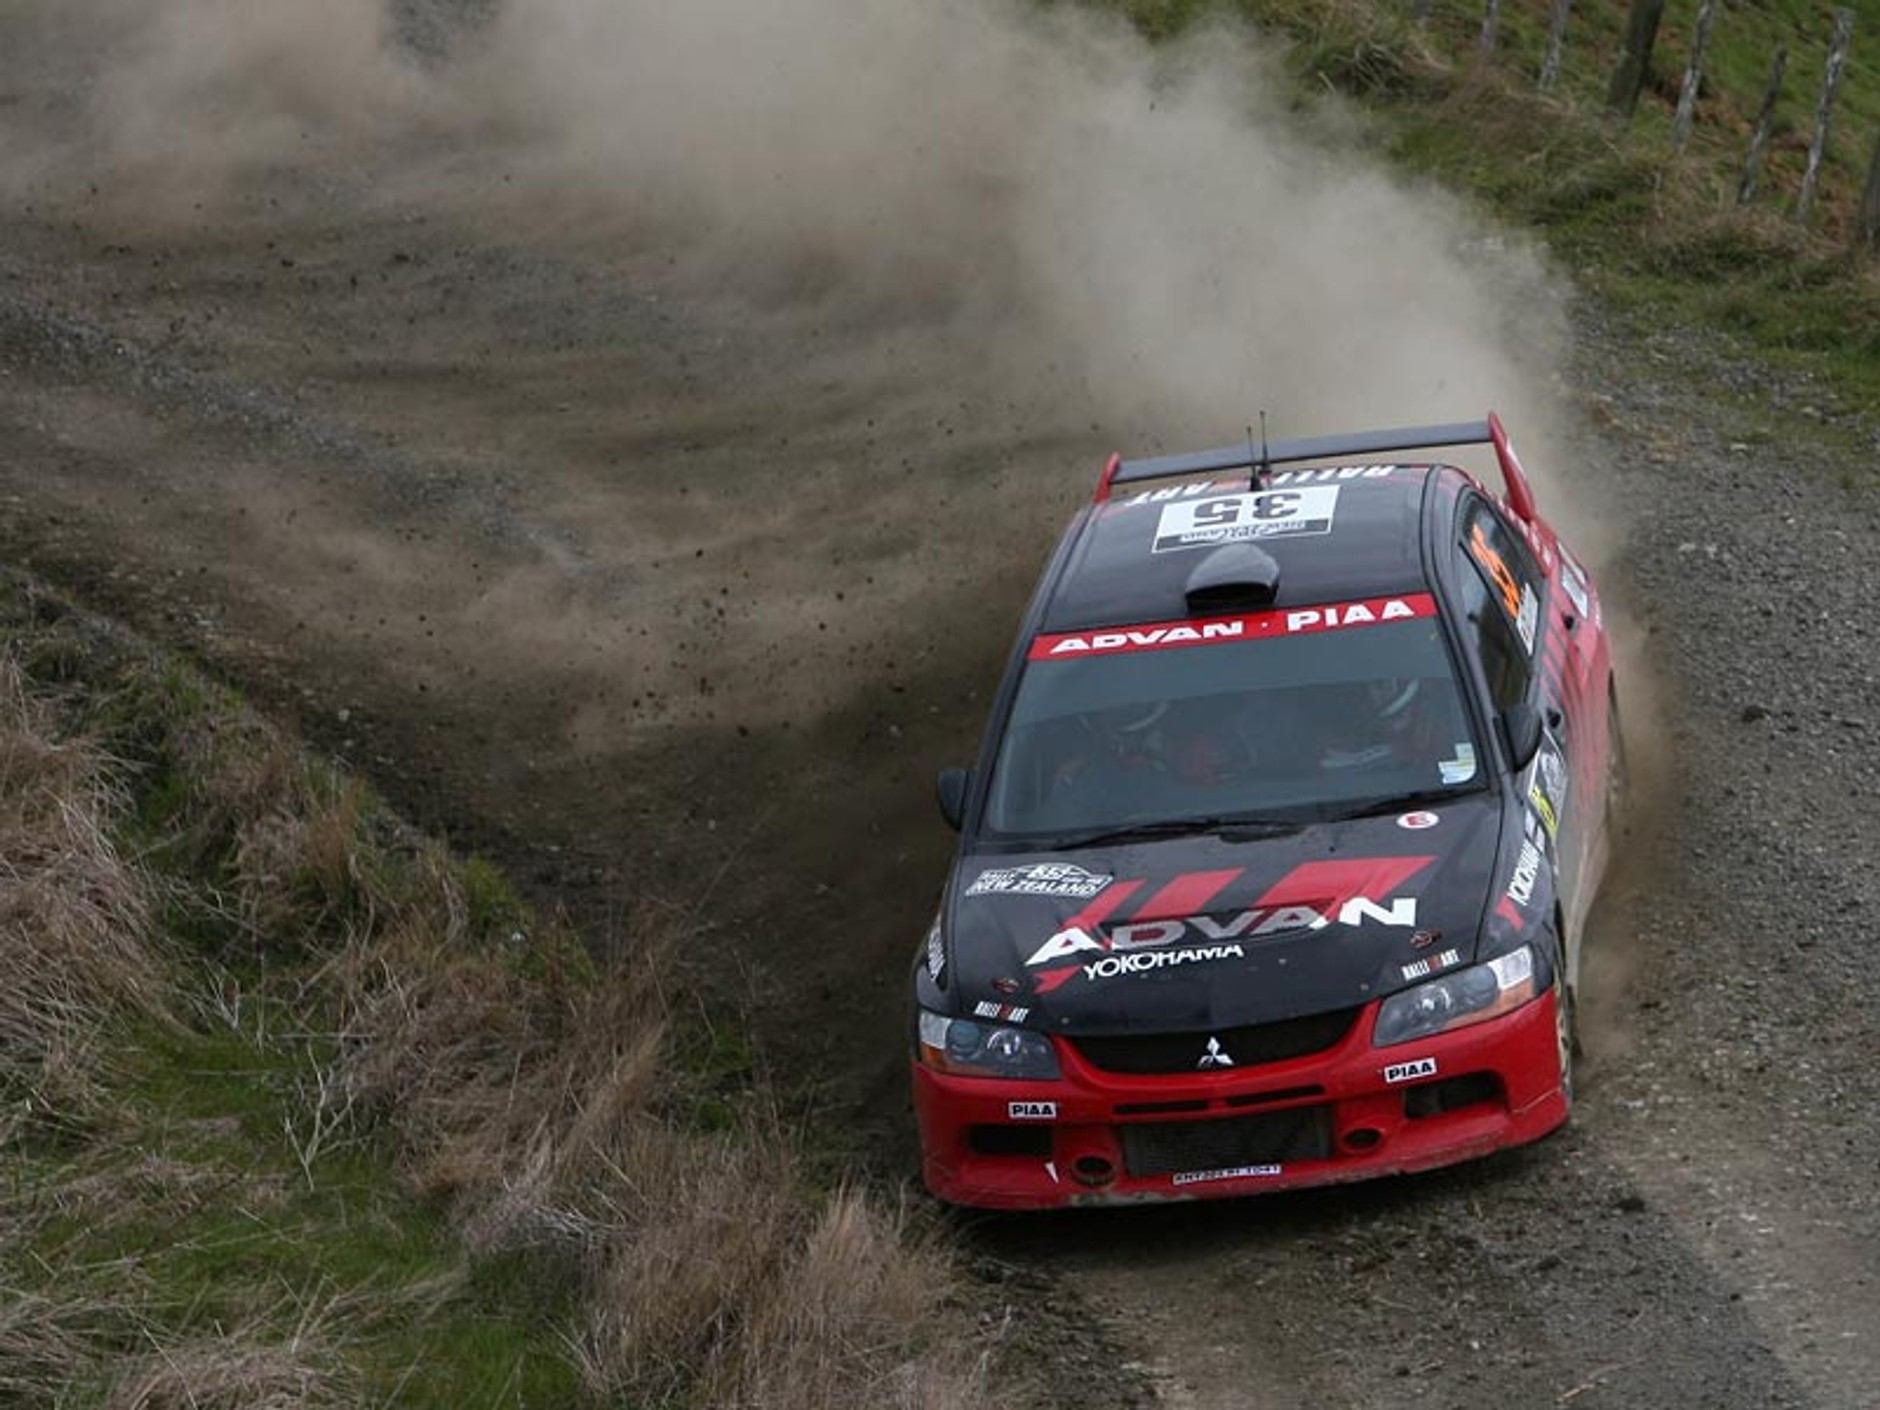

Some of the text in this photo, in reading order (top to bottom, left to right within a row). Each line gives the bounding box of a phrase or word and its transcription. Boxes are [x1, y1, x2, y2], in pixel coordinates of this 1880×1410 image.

[1193, 493, 1303, 528] 35
[1050, 600, 1415, 654] ADVAN PIAA
[1024, 897, 1417, 967] ADVAN
[1083, 944, 1244, 980] YOKOHAMA
[1388, 1061, 1433, 1080] PIAA
[1012, 1103, 1053, 1116] PIAA
